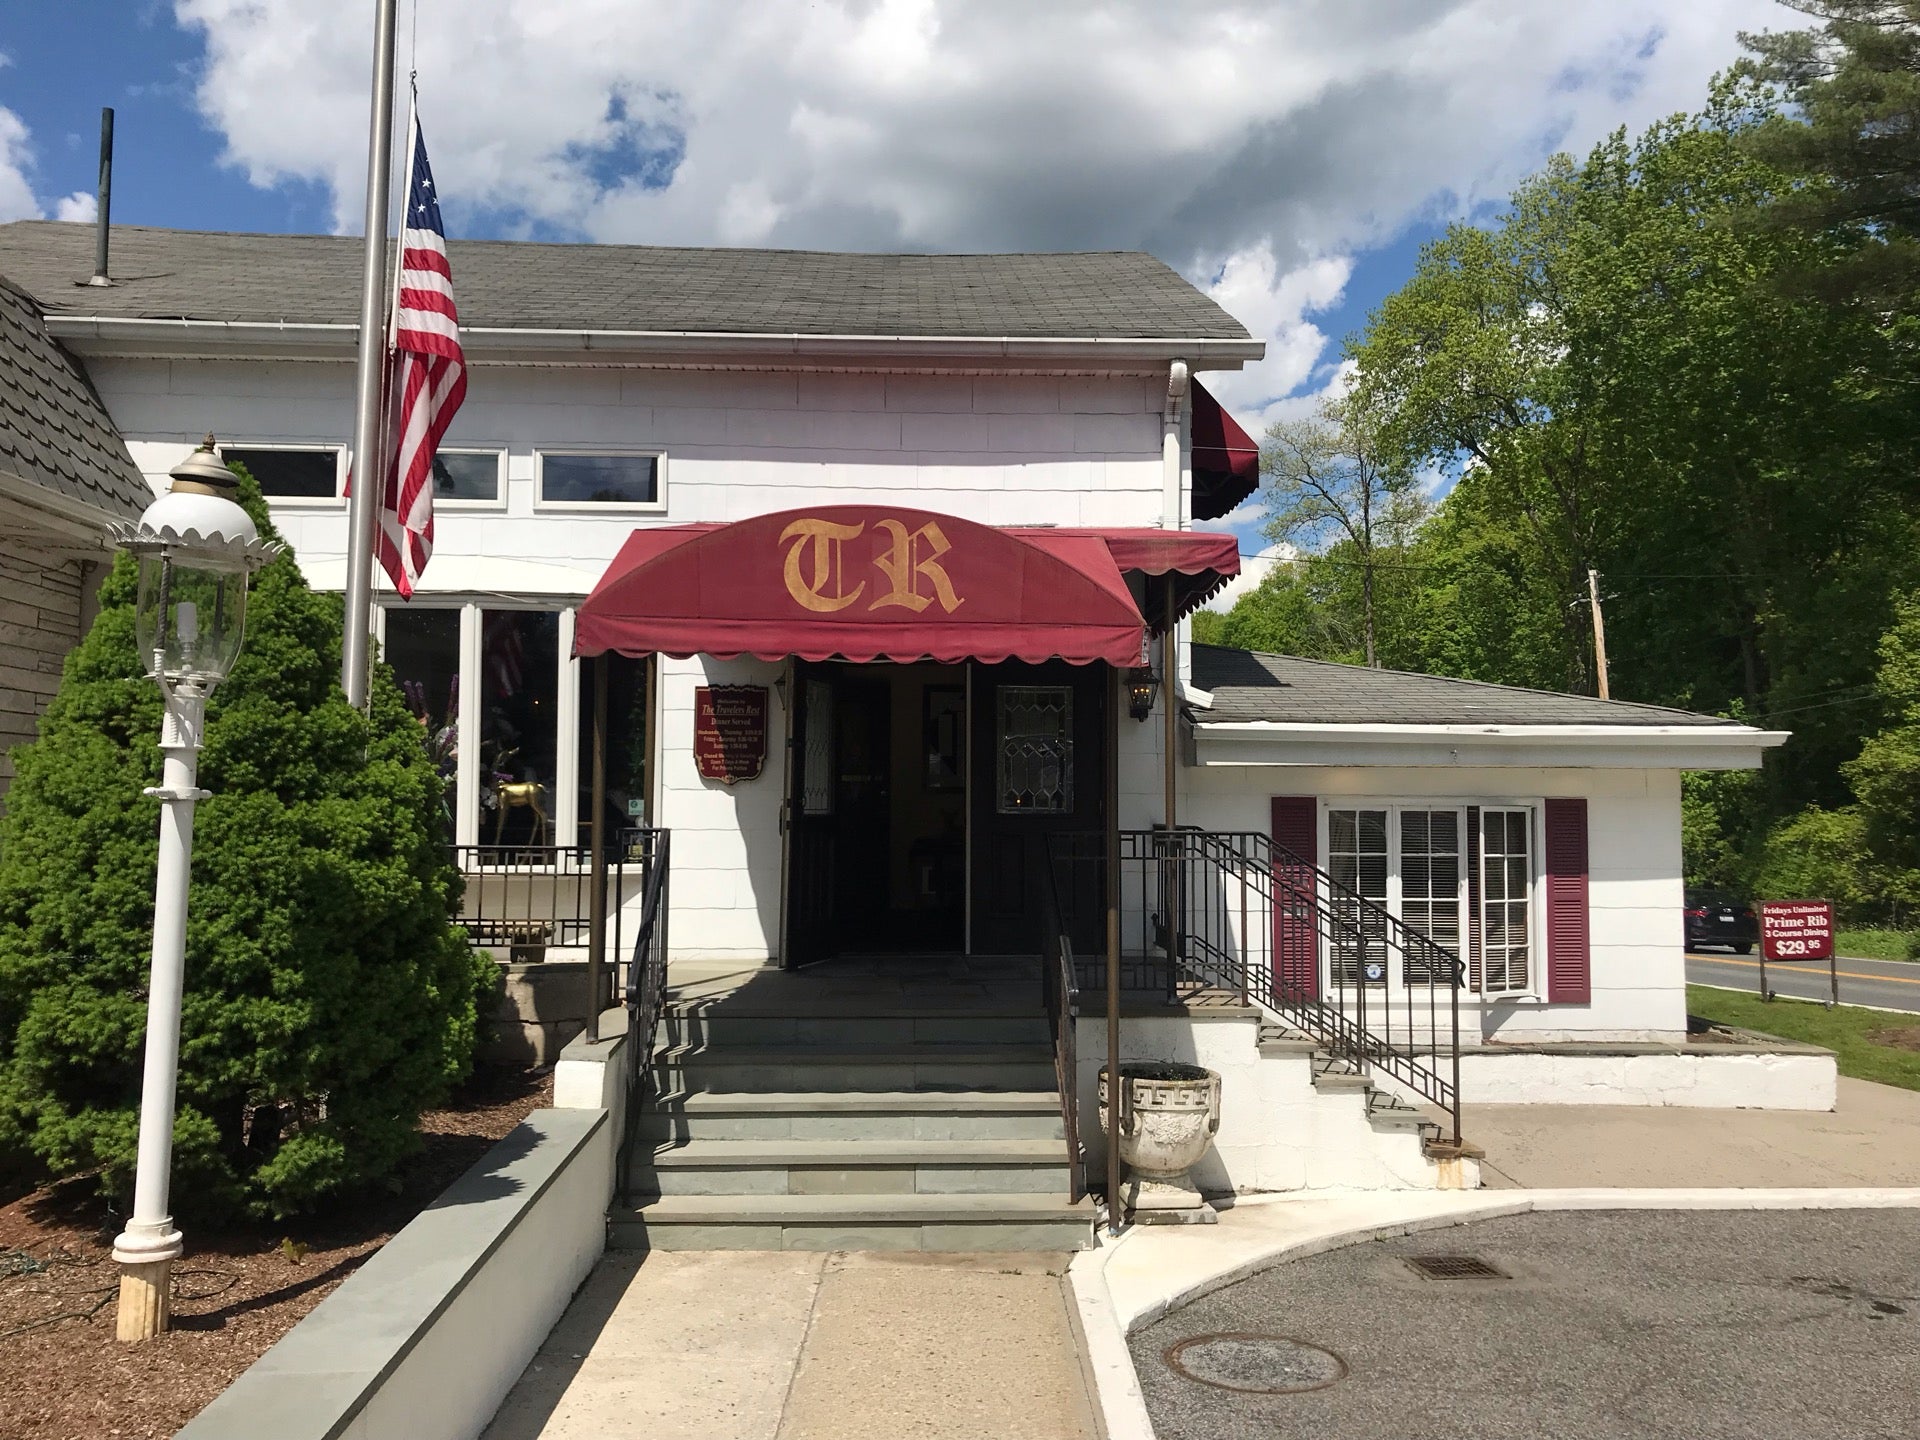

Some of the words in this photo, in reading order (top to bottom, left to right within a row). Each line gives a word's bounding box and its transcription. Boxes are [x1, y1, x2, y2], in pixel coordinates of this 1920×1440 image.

[702, 704, 715, 715] The
[716, 704, 744, 715] Travelers
[746, 705, 760, 715] Rest
[1763, 907, 1792, 915] Fridays
[1793, 905, 1828, 913] Unlimited
[1764, 916, 1805, 928] Prime
[1807, 915, 1828, 926] Rib
[1772, 929, 1802, 937] Course
[1803, 929, 1829, 937] Dining
